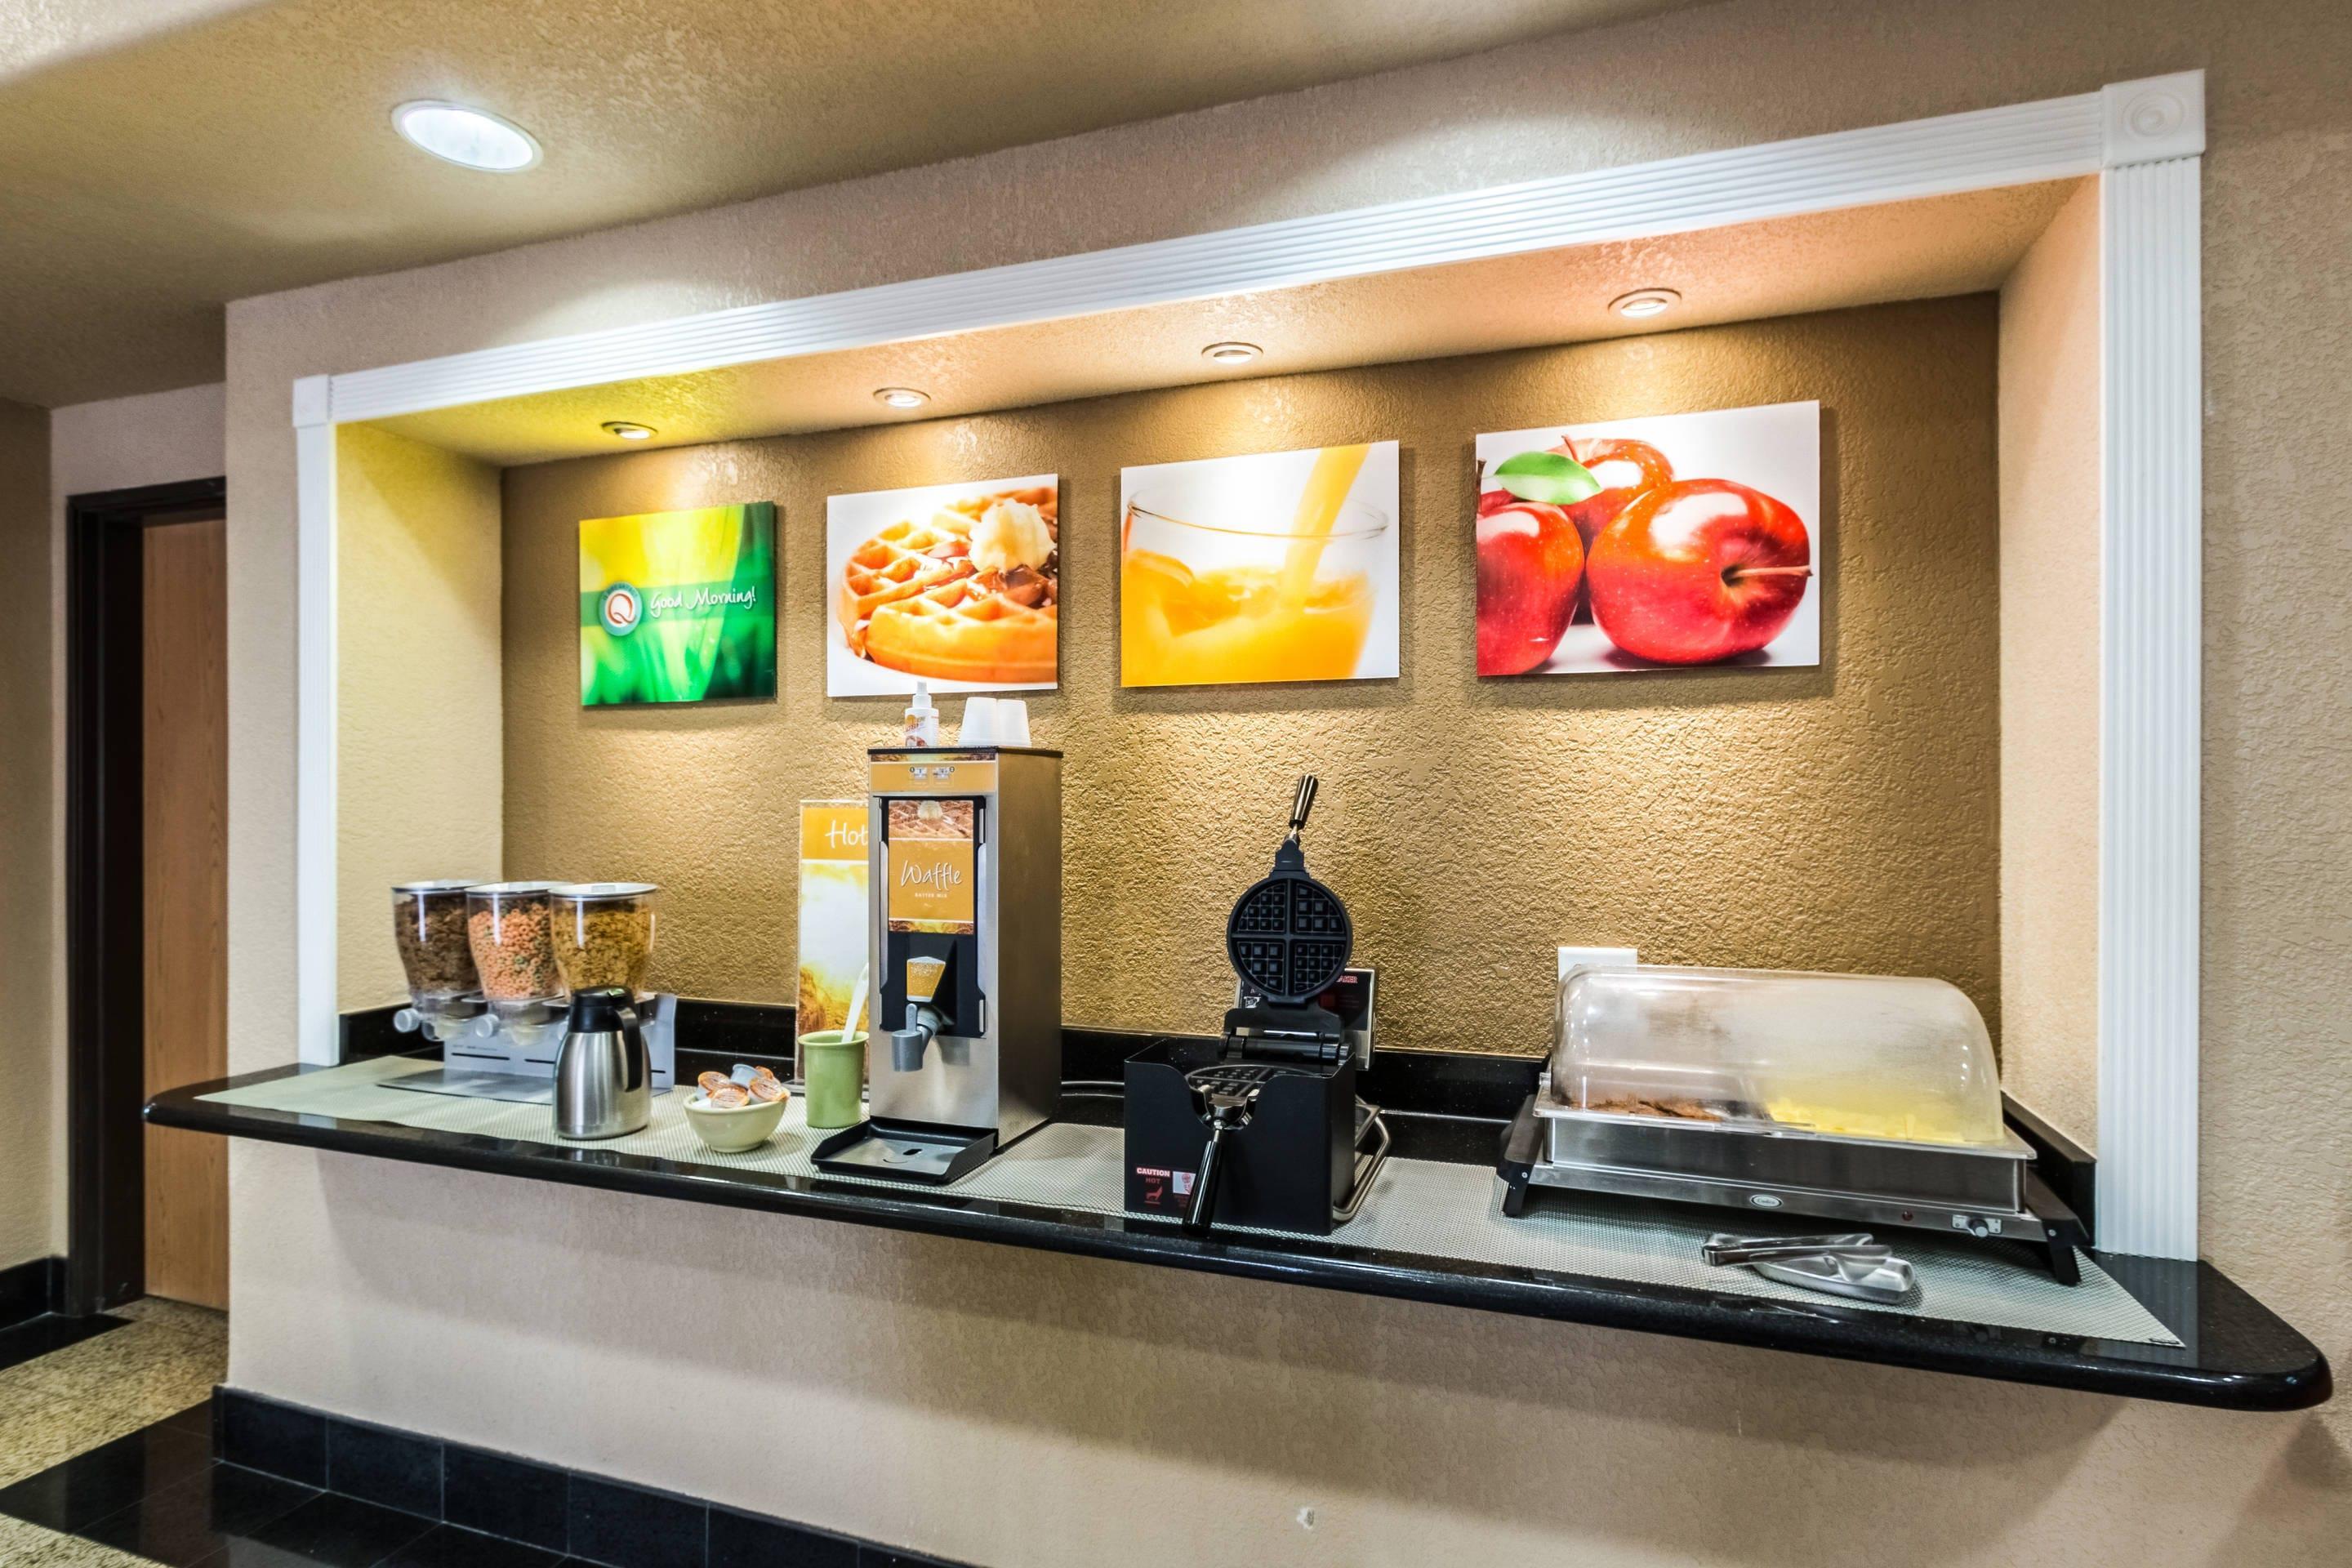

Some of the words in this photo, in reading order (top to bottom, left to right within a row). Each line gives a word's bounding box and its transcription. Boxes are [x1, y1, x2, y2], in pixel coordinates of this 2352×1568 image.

[608, 593, 637, 624] Q
[650, 591, 682, 618] Good
[687, 586, 756, 609] Morning!
[824, 819, 868, 849] Hot
[901, 860, 963, 891] Waffle
[1336, 975, 1358, 983] AKER
[1136, 1167, 1170, 1178] CAUTION
